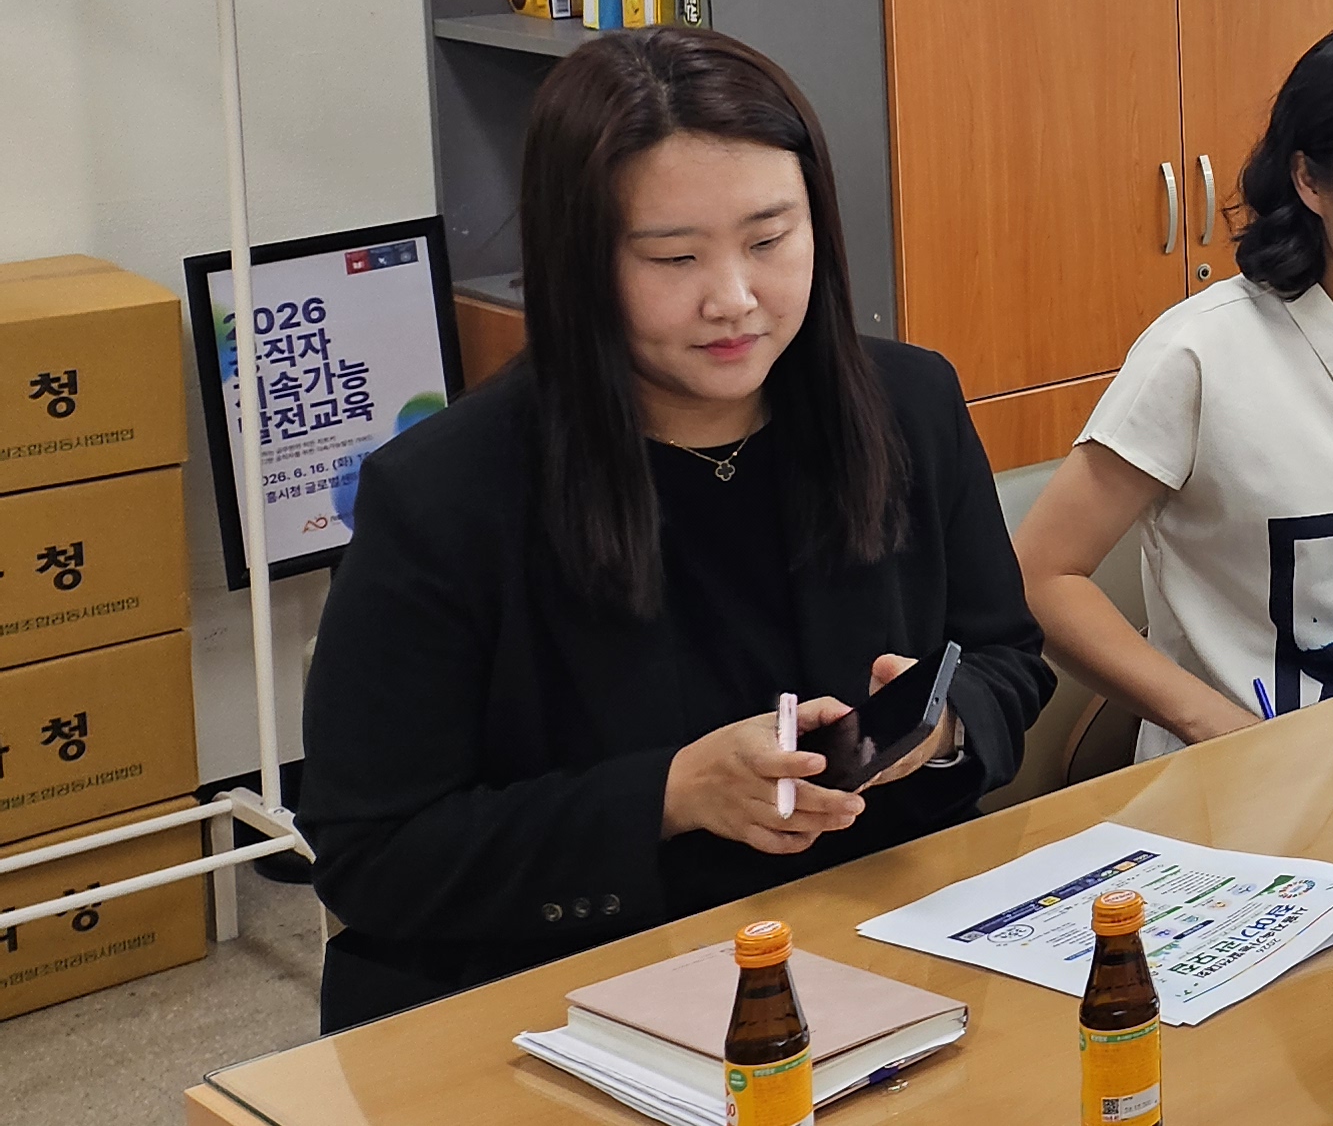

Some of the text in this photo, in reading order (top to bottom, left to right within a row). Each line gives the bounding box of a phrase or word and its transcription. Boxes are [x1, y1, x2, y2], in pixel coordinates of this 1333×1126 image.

[28, 369, 78, 419] 청
[266, 485, 301, 504] 흥시청
[35, 541, 84, 591] 청
[41, 711, 88, 762] 청
[1169, 904, 1296, 975] 참여기관 모집
